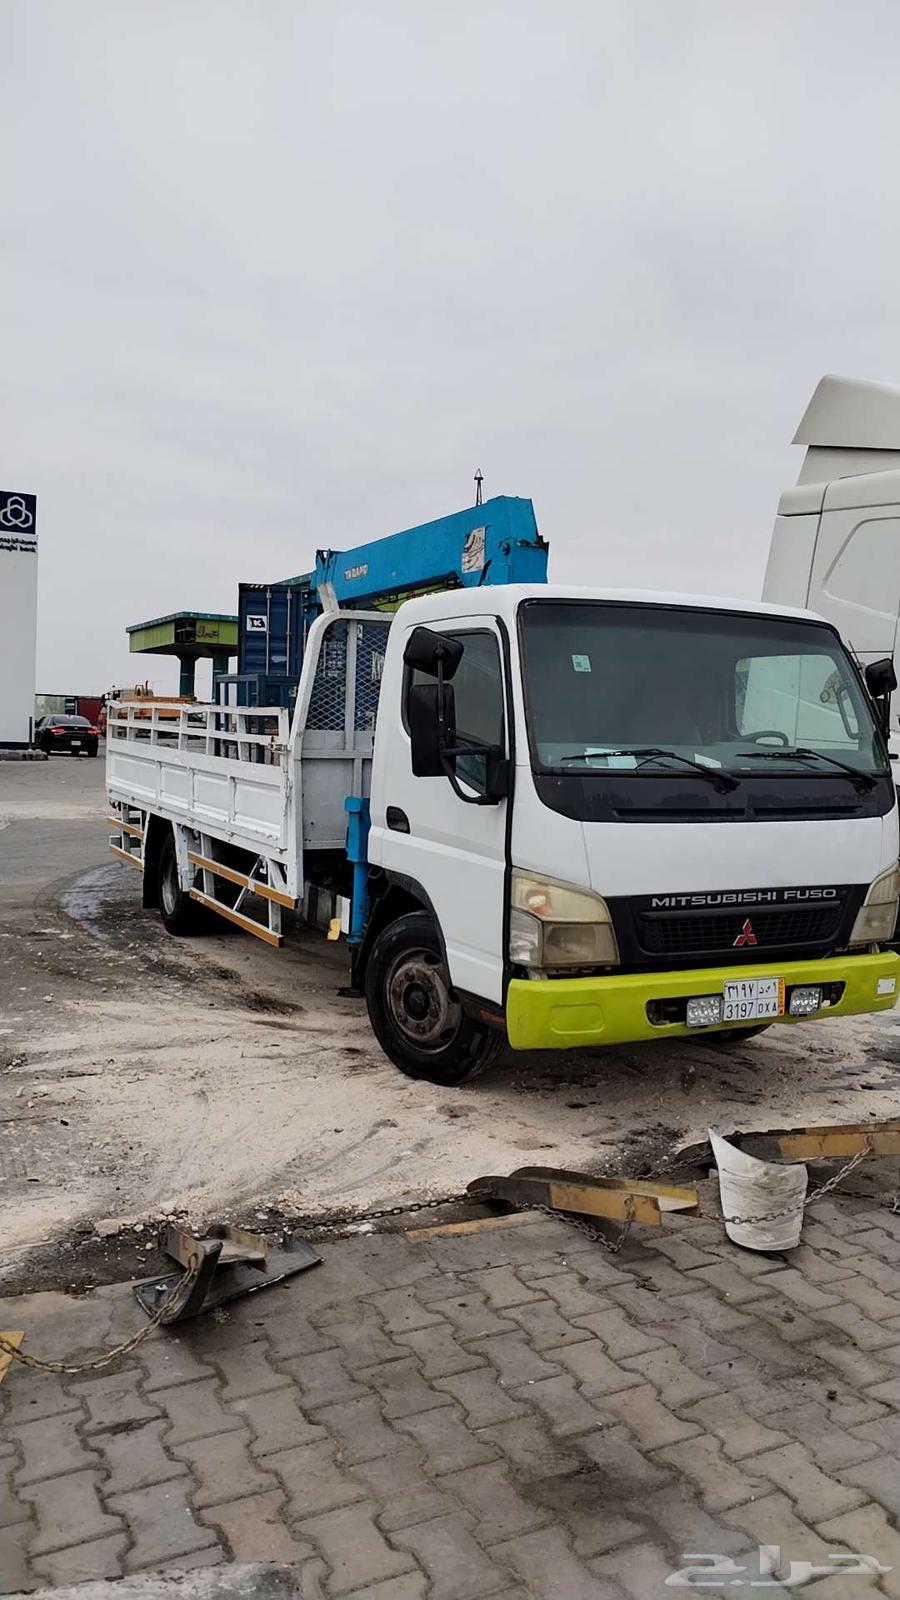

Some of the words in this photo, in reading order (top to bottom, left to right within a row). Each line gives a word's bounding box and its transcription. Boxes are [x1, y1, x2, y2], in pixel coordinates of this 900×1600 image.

[651, 890, 777, 908] MITSUBISHI
[783, 888, 838, 900] FUSO
[726, 1001, 754, 1019] 3197
